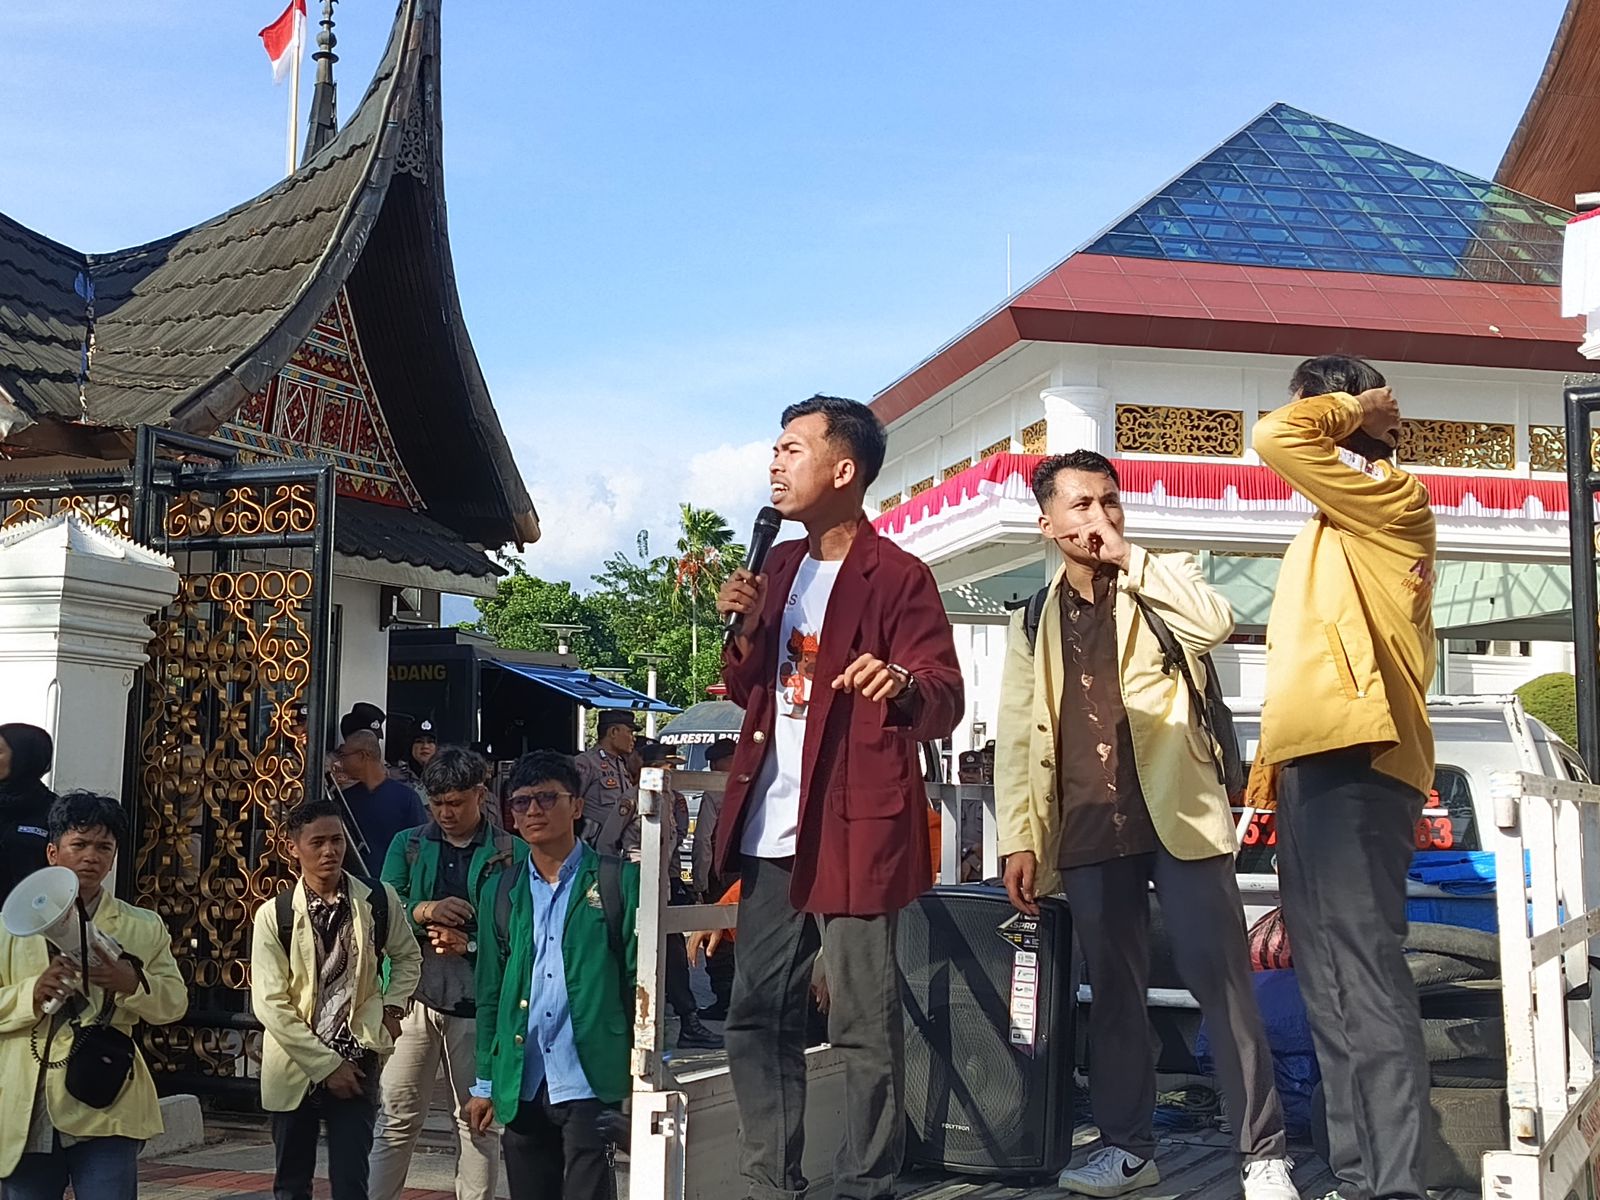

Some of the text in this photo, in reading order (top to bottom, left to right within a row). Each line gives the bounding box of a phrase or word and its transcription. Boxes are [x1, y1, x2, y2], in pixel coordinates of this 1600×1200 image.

[660, 733, 716, 745] POLRESTA
[1415, 817, 1453, 849] 83
[1010, 922, 1038, 930] SPRO
